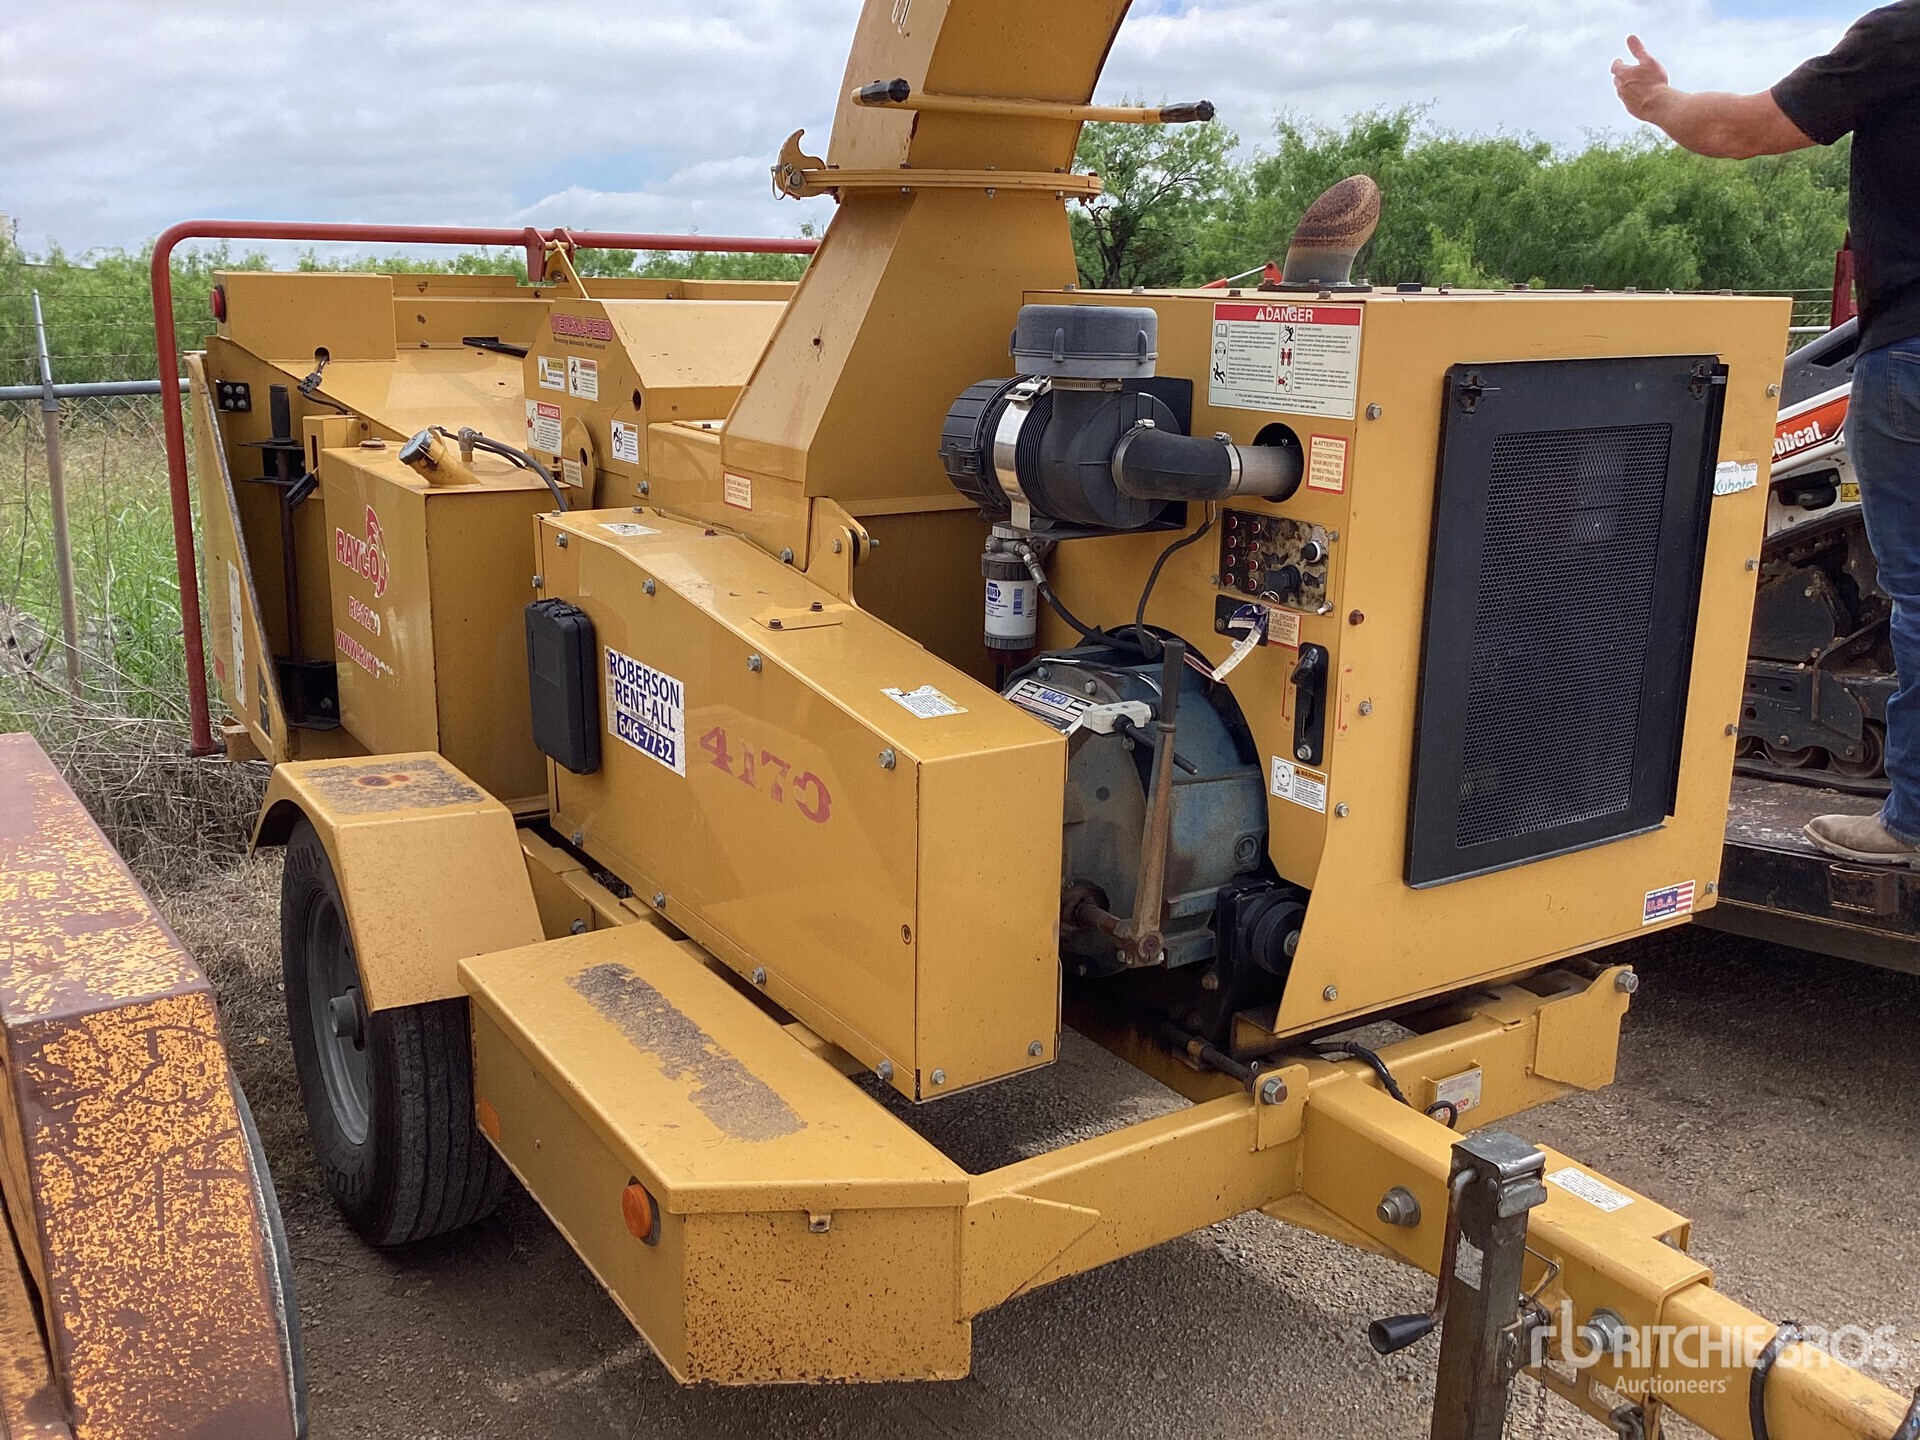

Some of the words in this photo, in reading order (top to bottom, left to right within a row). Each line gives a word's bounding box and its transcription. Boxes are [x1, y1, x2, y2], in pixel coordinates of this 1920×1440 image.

[1265, 307, 1314, 323] DANGER
[1772, 420, 1823, 458] obcat
[336, 527, 380, 585] RAYCO
[609, 652, 680, 709] ROBERSON
[1040, 690, 1069, 705] NACD
[615, 679, 676, 733] RENT-ALL
[619, 715, 673, 763] 646-7732
